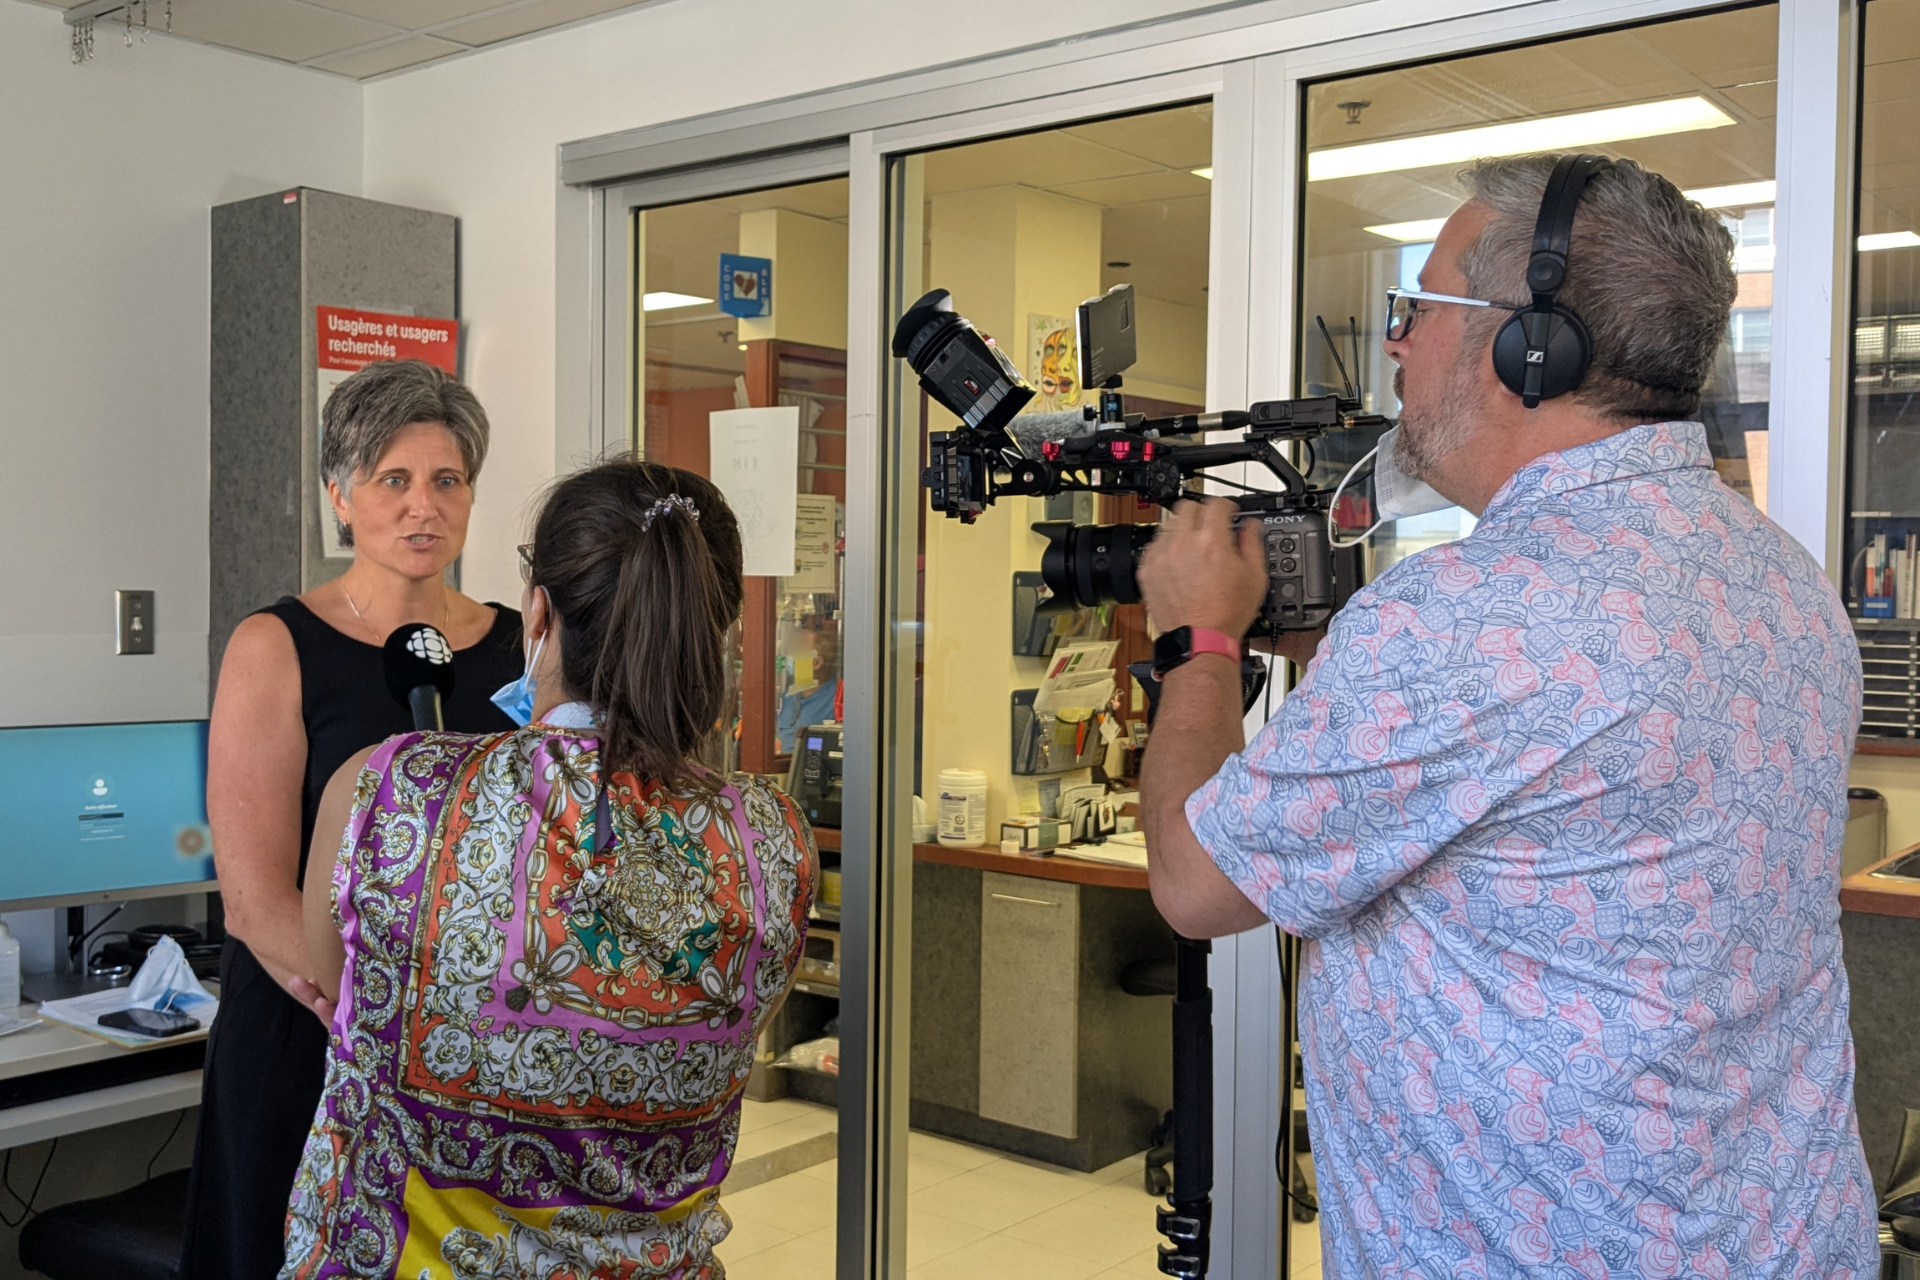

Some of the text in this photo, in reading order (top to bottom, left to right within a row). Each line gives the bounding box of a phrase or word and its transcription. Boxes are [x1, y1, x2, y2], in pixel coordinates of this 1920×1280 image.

[723, 264, 731, 301] CODE
[327, 314, 449, 344] Usagères et usagers
[328, 338, 396, 357] recherchés
[1263, 515, 1306, 525] SONY
